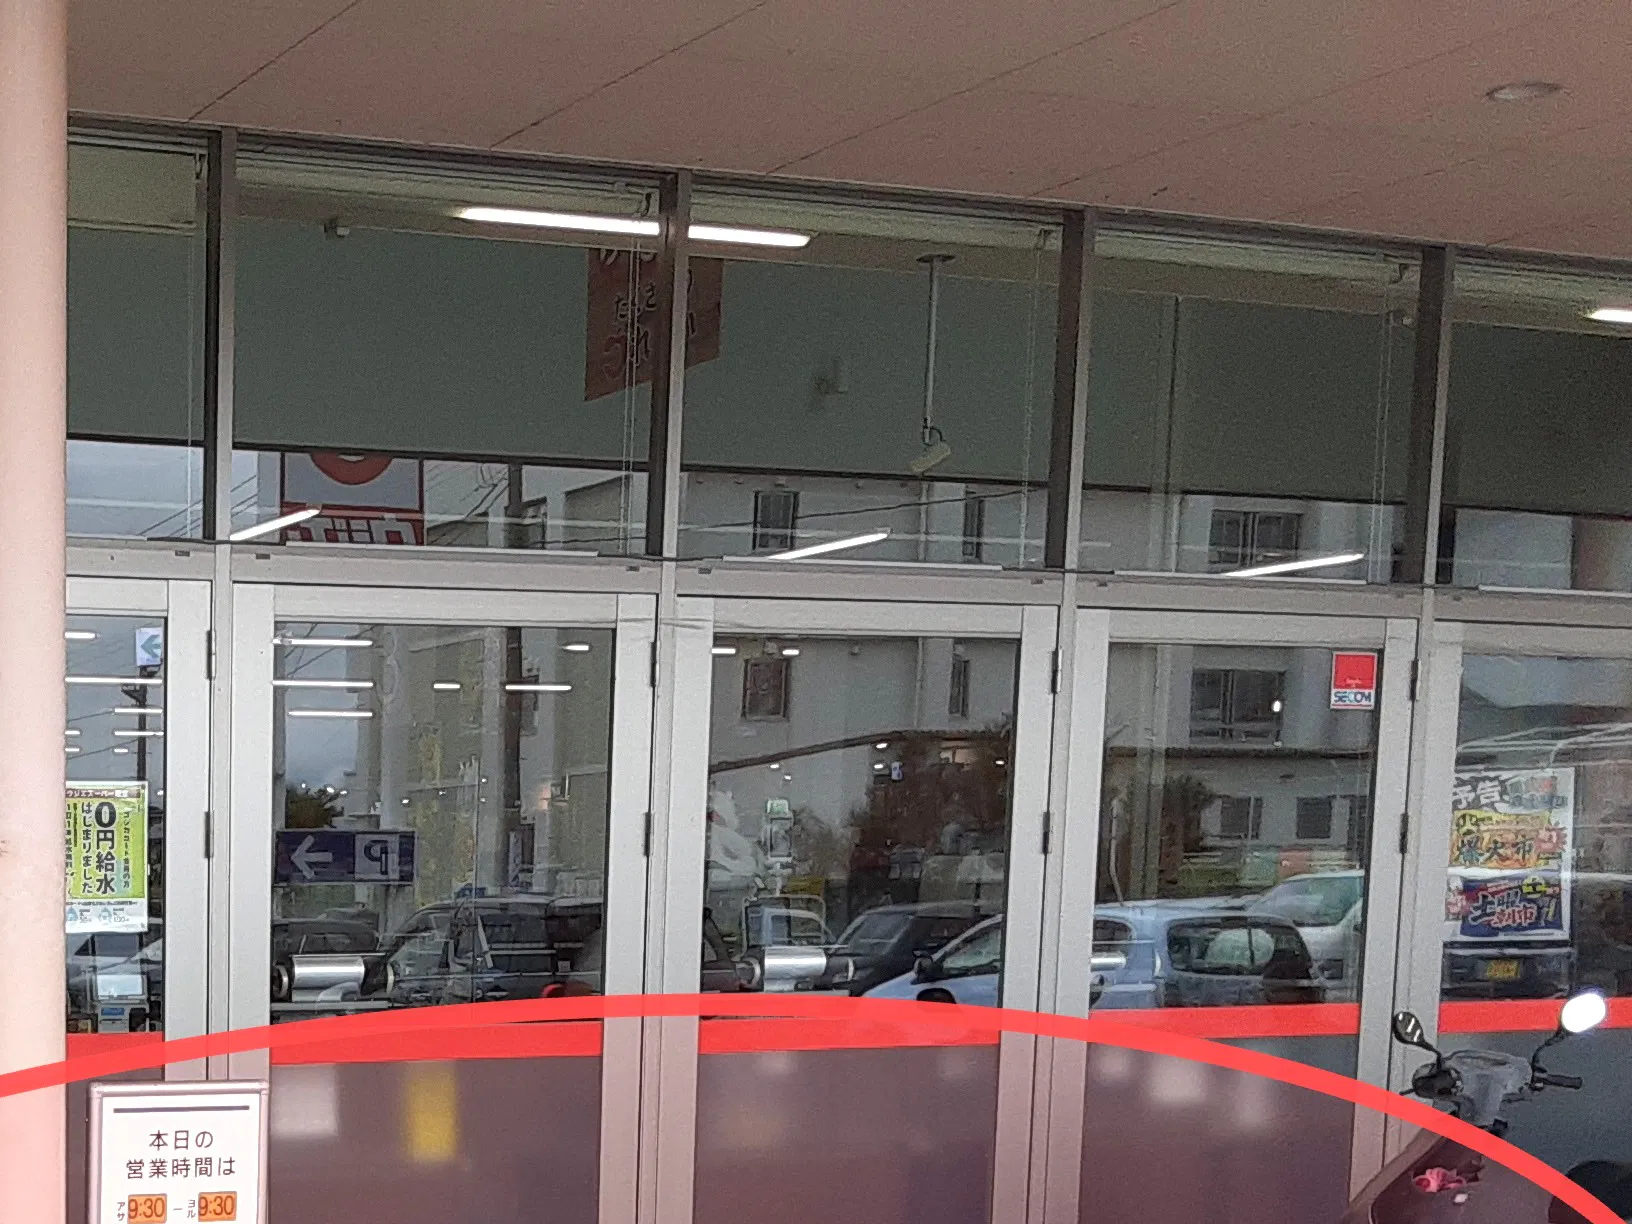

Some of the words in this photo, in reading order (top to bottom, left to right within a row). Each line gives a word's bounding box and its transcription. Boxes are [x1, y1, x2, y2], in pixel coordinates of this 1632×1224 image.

[1333, 691, 1372, 703] SECOM
[81, 801, 93, 893] はじまりました
[95, 801, 116, 895] 0円給水
[148, 1130, 214, 1151] 本日の
[126, 1157, 236, 1180] 営業時間は
[117, 1201, 126, 1221] アサ
[128, 1198, 165, 1219] 9:30
[187, 1199, 196, 1218] ヨル
[198, 1195, 235, 1216] 9:30
